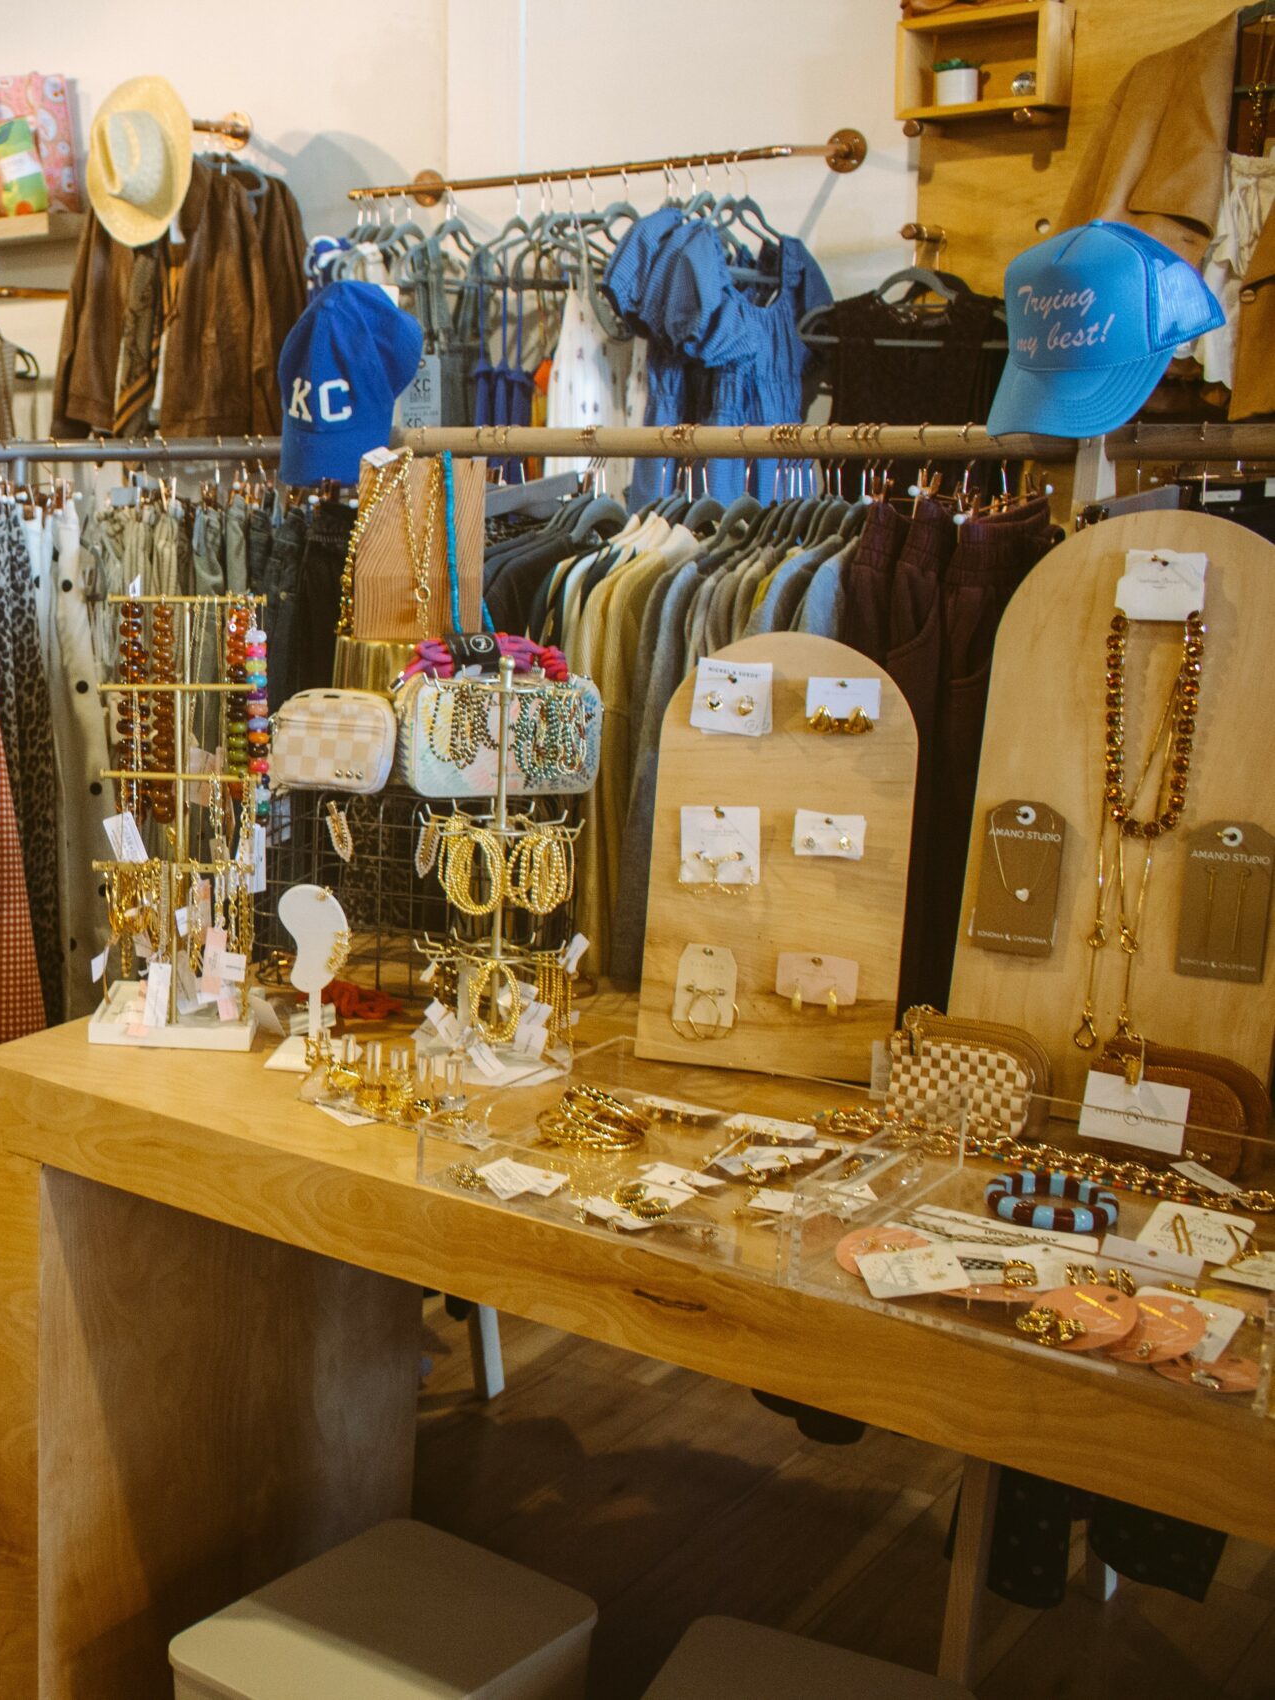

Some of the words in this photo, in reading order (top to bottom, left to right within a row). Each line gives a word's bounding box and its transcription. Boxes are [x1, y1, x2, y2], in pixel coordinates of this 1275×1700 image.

[1017, 285, 1095, 319] Trying
[1016, 336, 1038, 359] my
[1047, 313, 1115, 350] best!
[988, 828, 1025, 840] AMANO
[1027, 831, 1061, 843] STUDIO
[1190, 850, 1230, 862] AMANO
[1232, 852, 1271, 865] STUDIO
